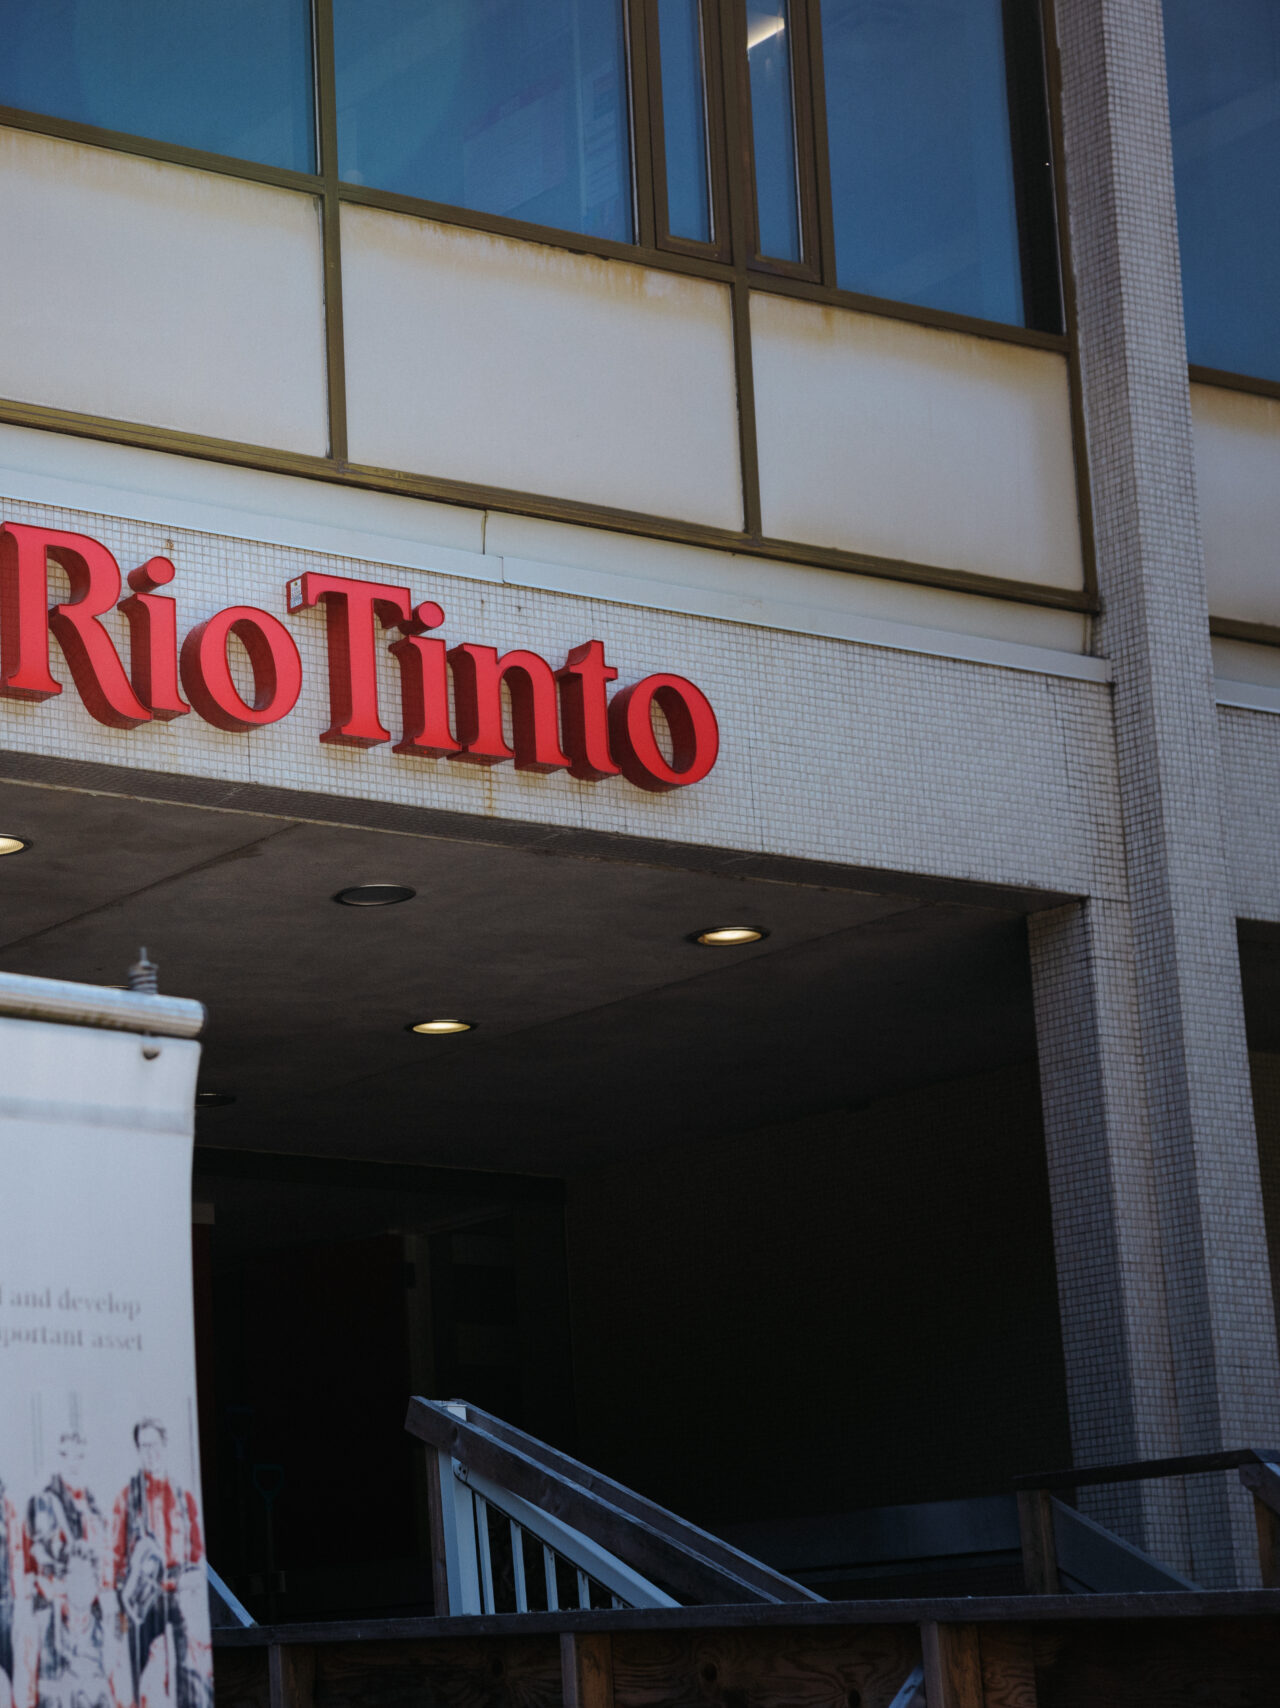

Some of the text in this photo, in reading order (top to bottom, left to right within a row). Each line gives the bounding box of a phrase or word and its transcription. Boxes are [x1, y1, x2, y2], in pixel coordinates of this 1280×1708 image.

[286, 571, 719, 792] Tinto
[10, 1288, 52, 1309] and
[58, 1288, 141, 1321] develop
[91, 1332, 143, 1351] asset
